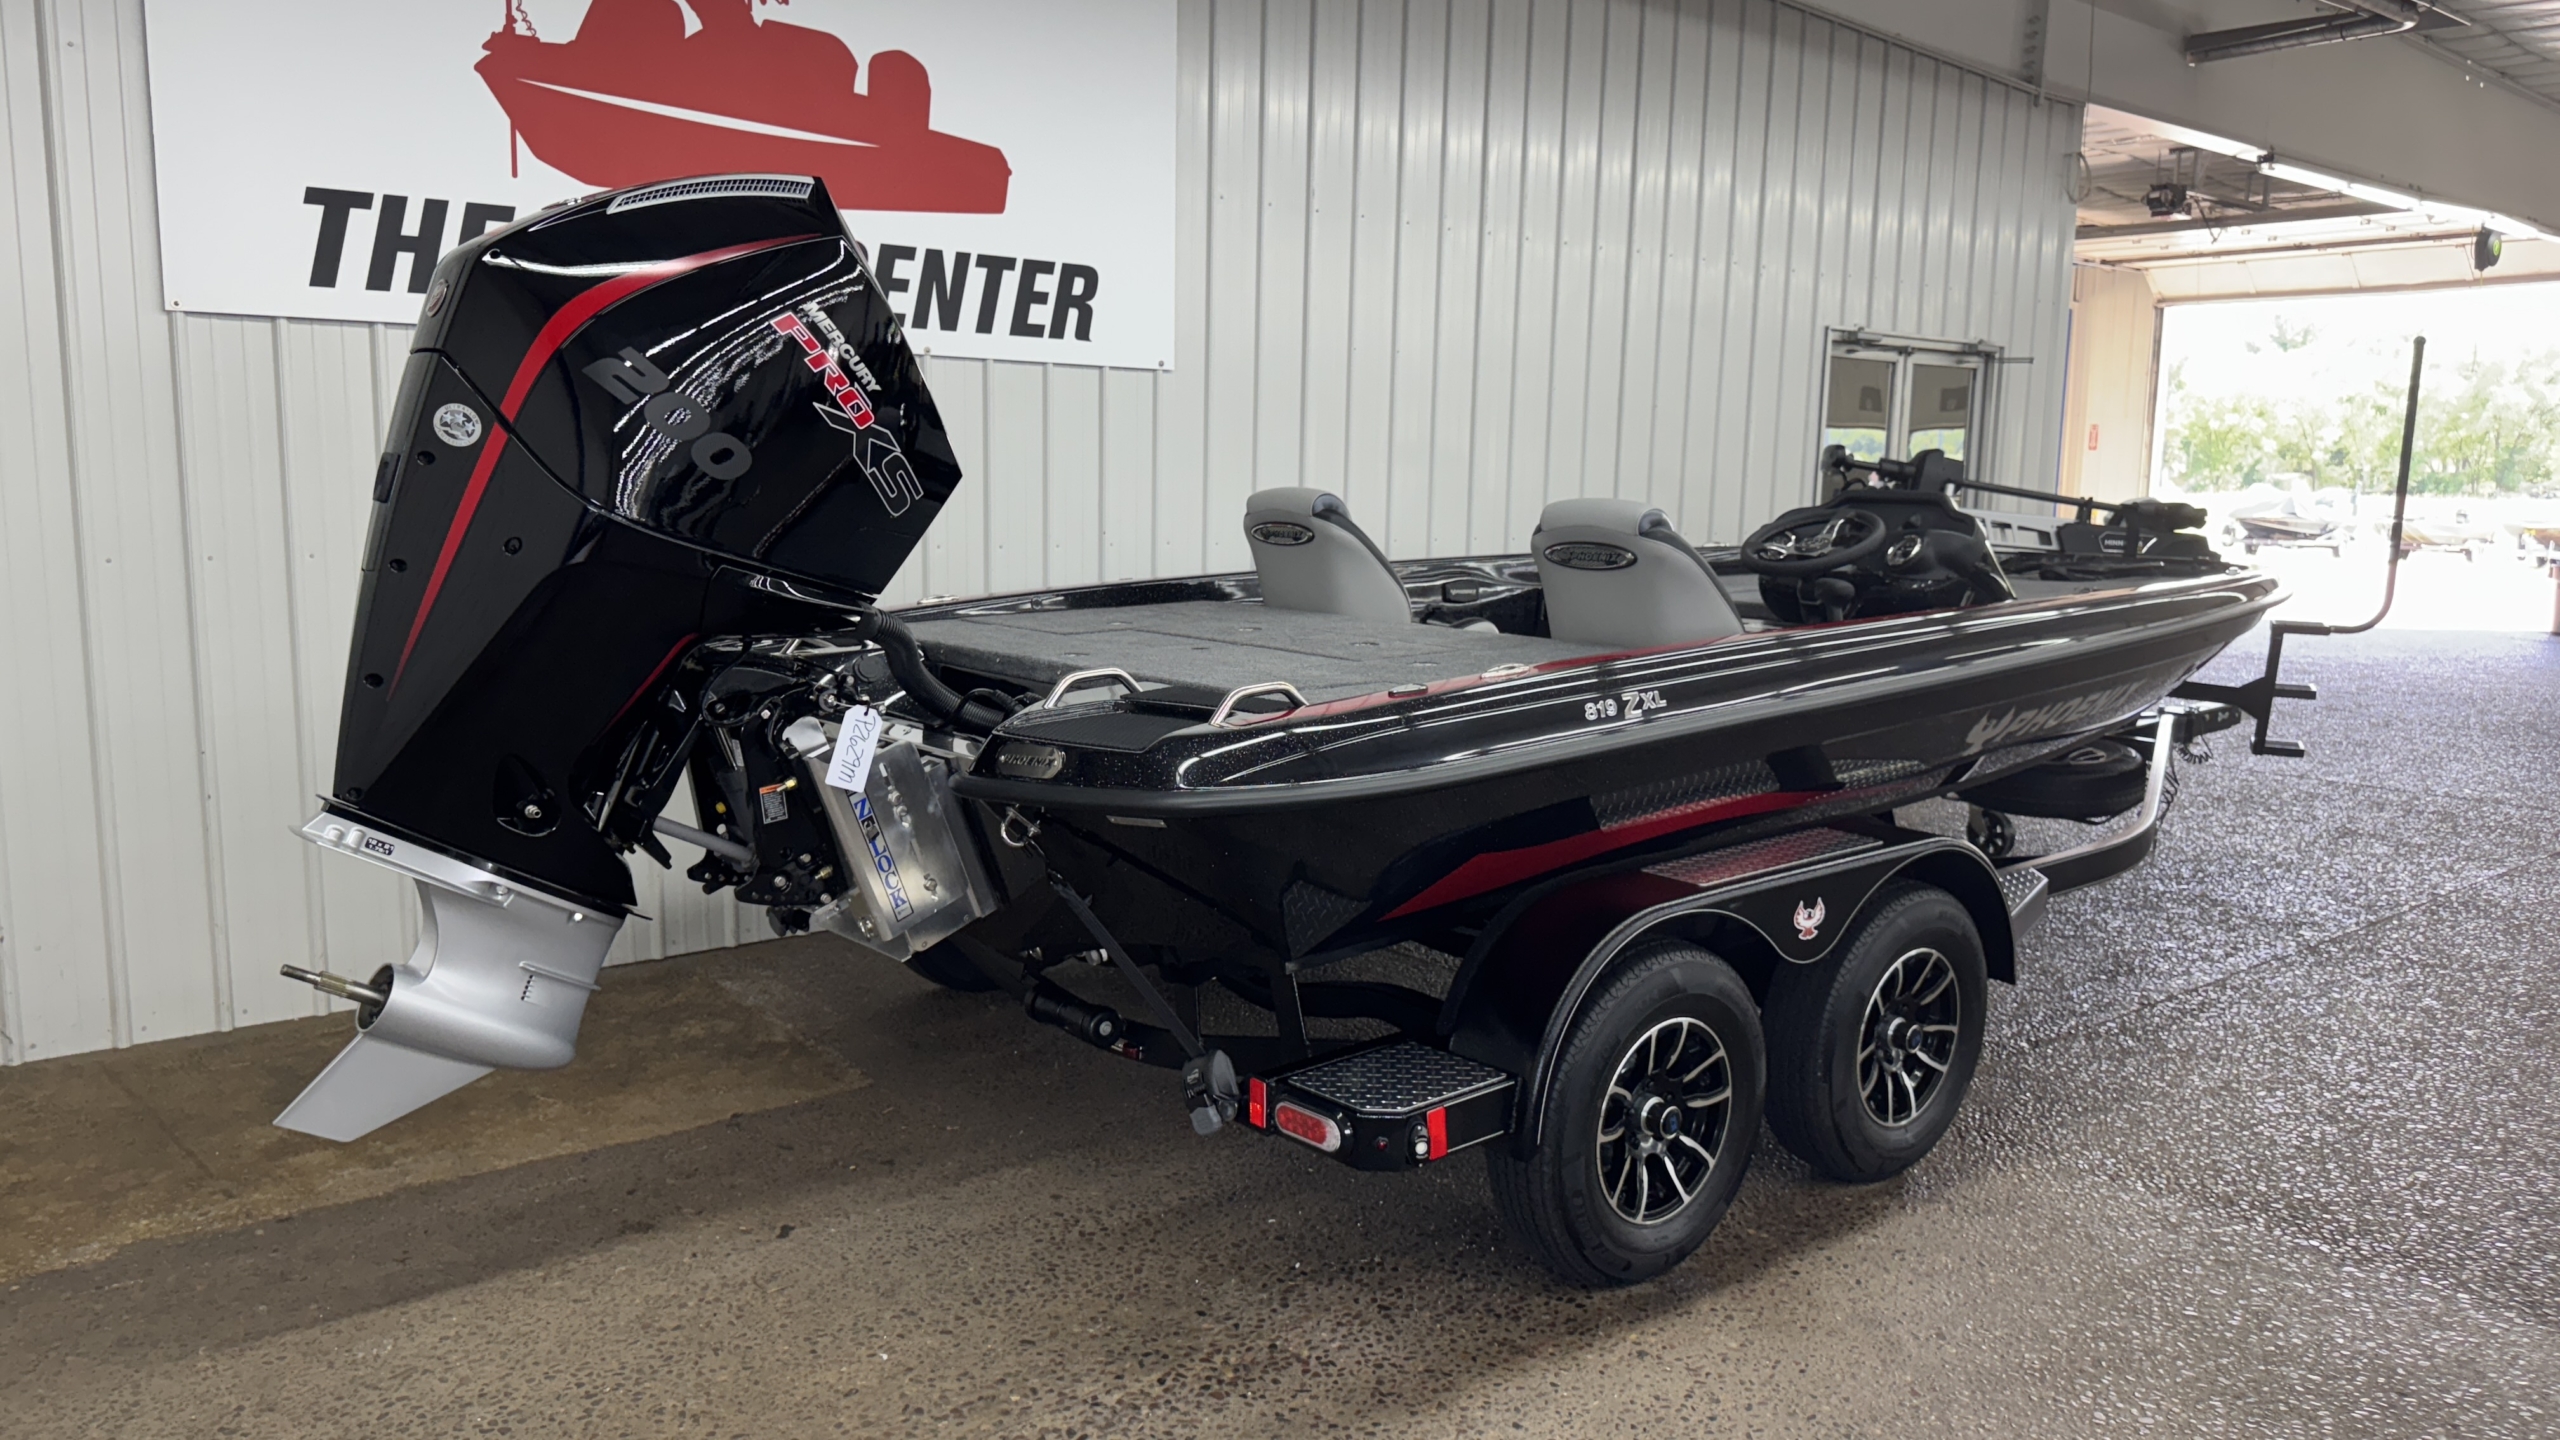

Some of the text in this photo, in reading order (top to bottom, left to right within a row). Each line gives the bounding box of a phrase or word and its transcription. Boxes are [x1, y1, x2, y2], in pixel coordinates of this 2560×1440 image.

[855, 240, 1099, 342] ENTER
[803, 301, 882, 392] MERCURY
[581, 346, 752, 480] 200
[769, 311, 924, 516] PRO XS
[1584, 690, 1667, 721] 819 ZXL
[2008, 679, 2147, 737] PHOENIX
